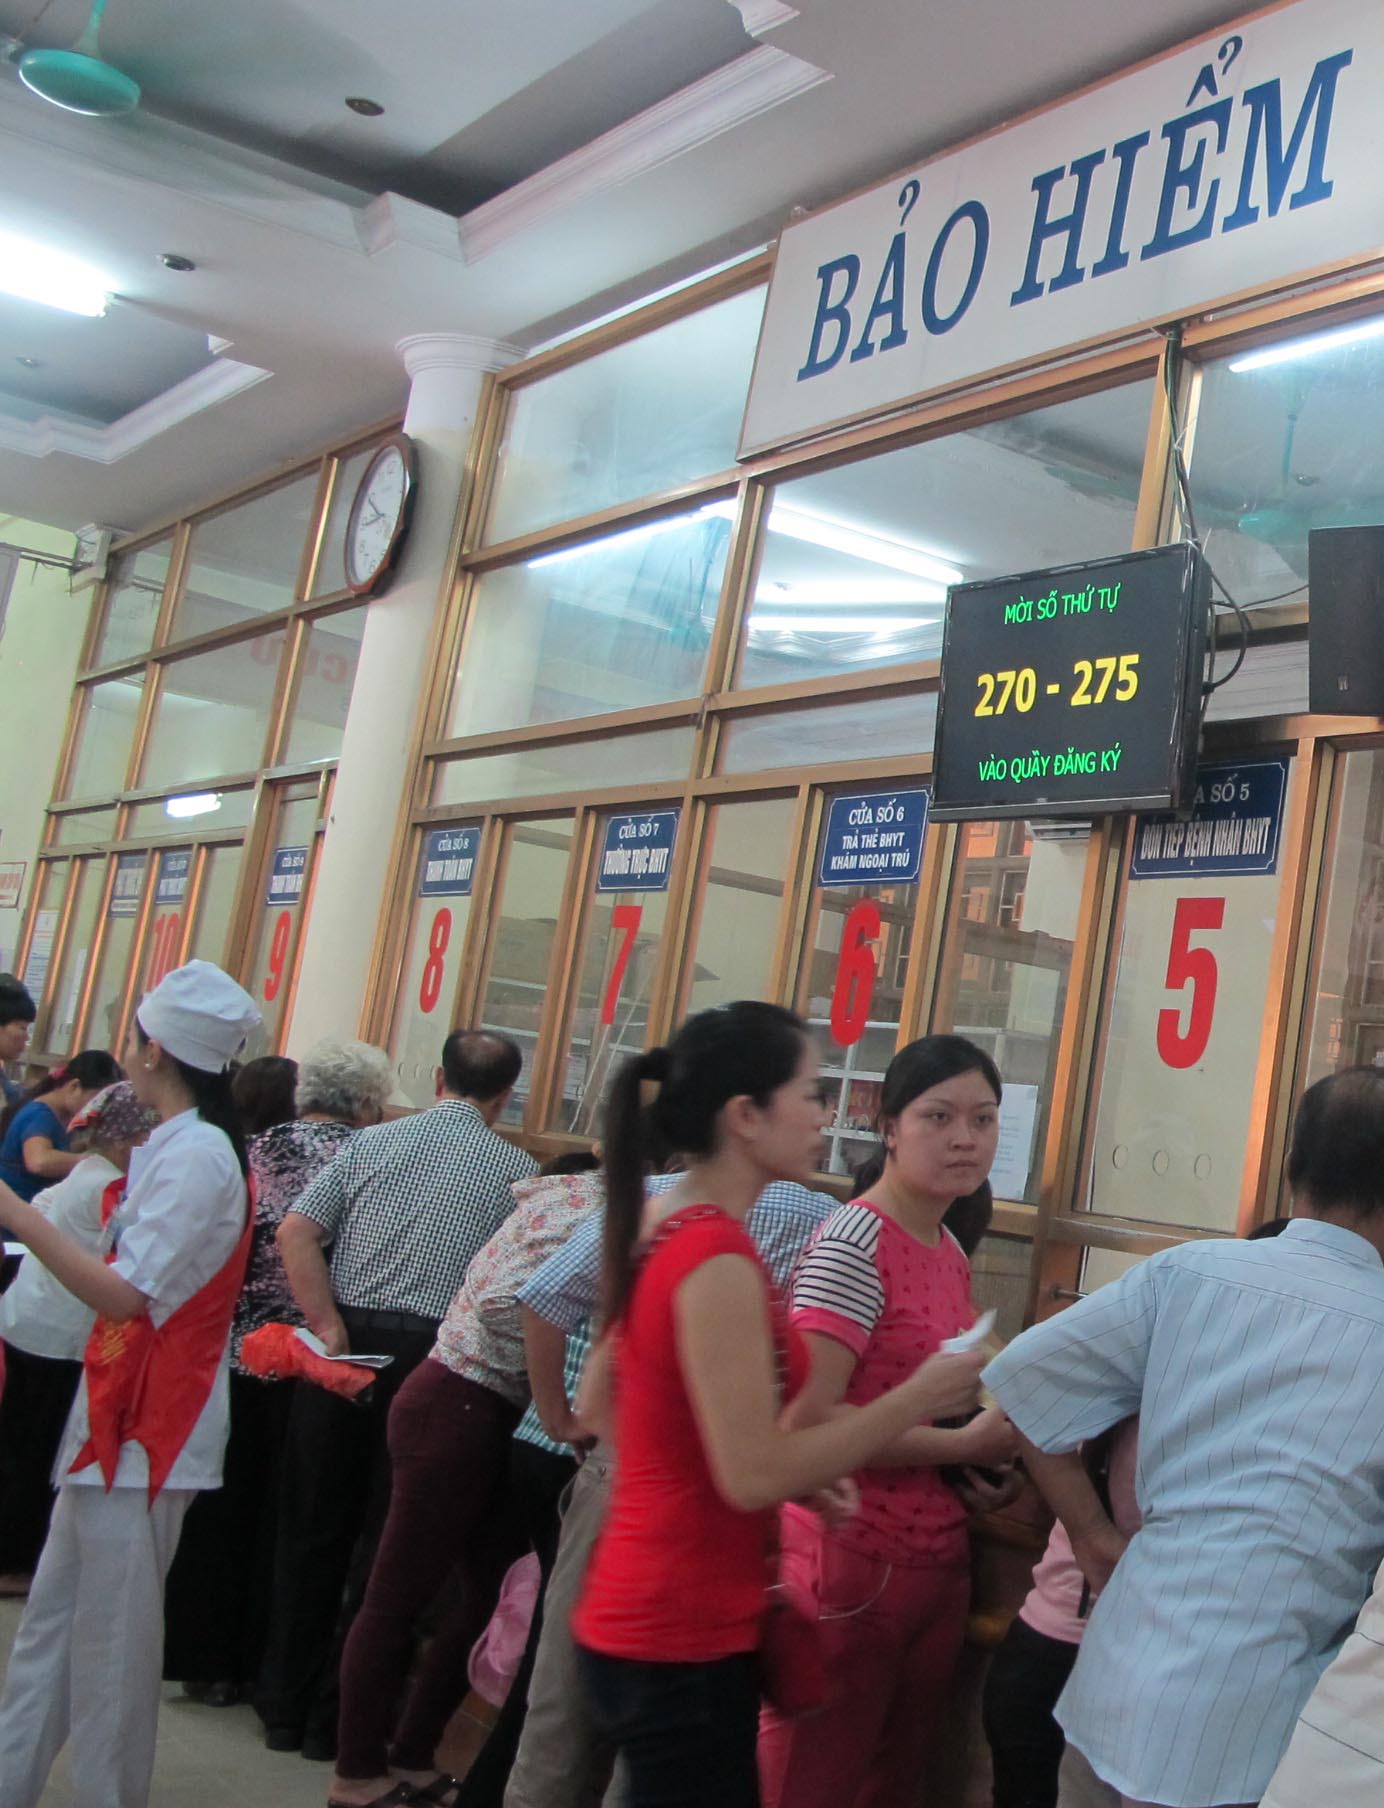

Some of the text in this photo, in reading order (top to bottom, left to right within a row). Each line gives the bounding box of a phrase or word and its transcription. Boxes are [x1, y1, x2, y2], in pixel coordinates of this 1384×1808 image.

[796, 180, 990, 382] BẢO
[1010, 35, 1354, 308] HIỂM
[1004, 582, 1121, 624] MỜI SỐ THỨ TỰ
[974, 668, 1036, 717] 270
[1070, 654, 1139, 706] 275
[979, 742, 1121, 783] VÀO QUẦY ĐĂNG KÝ
[1210, 773, 1238, 802] SỐ
[1240, 784, 1249, 800] 5
[653, 823, 660, 836] 7
[849, 798, 905, 825] CỬA SỐ 6
[842, 828, 905, 849] TRẢ THẺ BHYT
[1242, 817, 1271, 855] BHYT
[831, 848, 910, 872] KHÁM NGOẠI TRÚ
[264, 910, 291, 1001] 9
[419, 907, 452, 1013] 8
[602, 905, 643, 1025] 7
[830, 897, 880, 1047] 6
[1157, 897, 1225, 1069] 5
